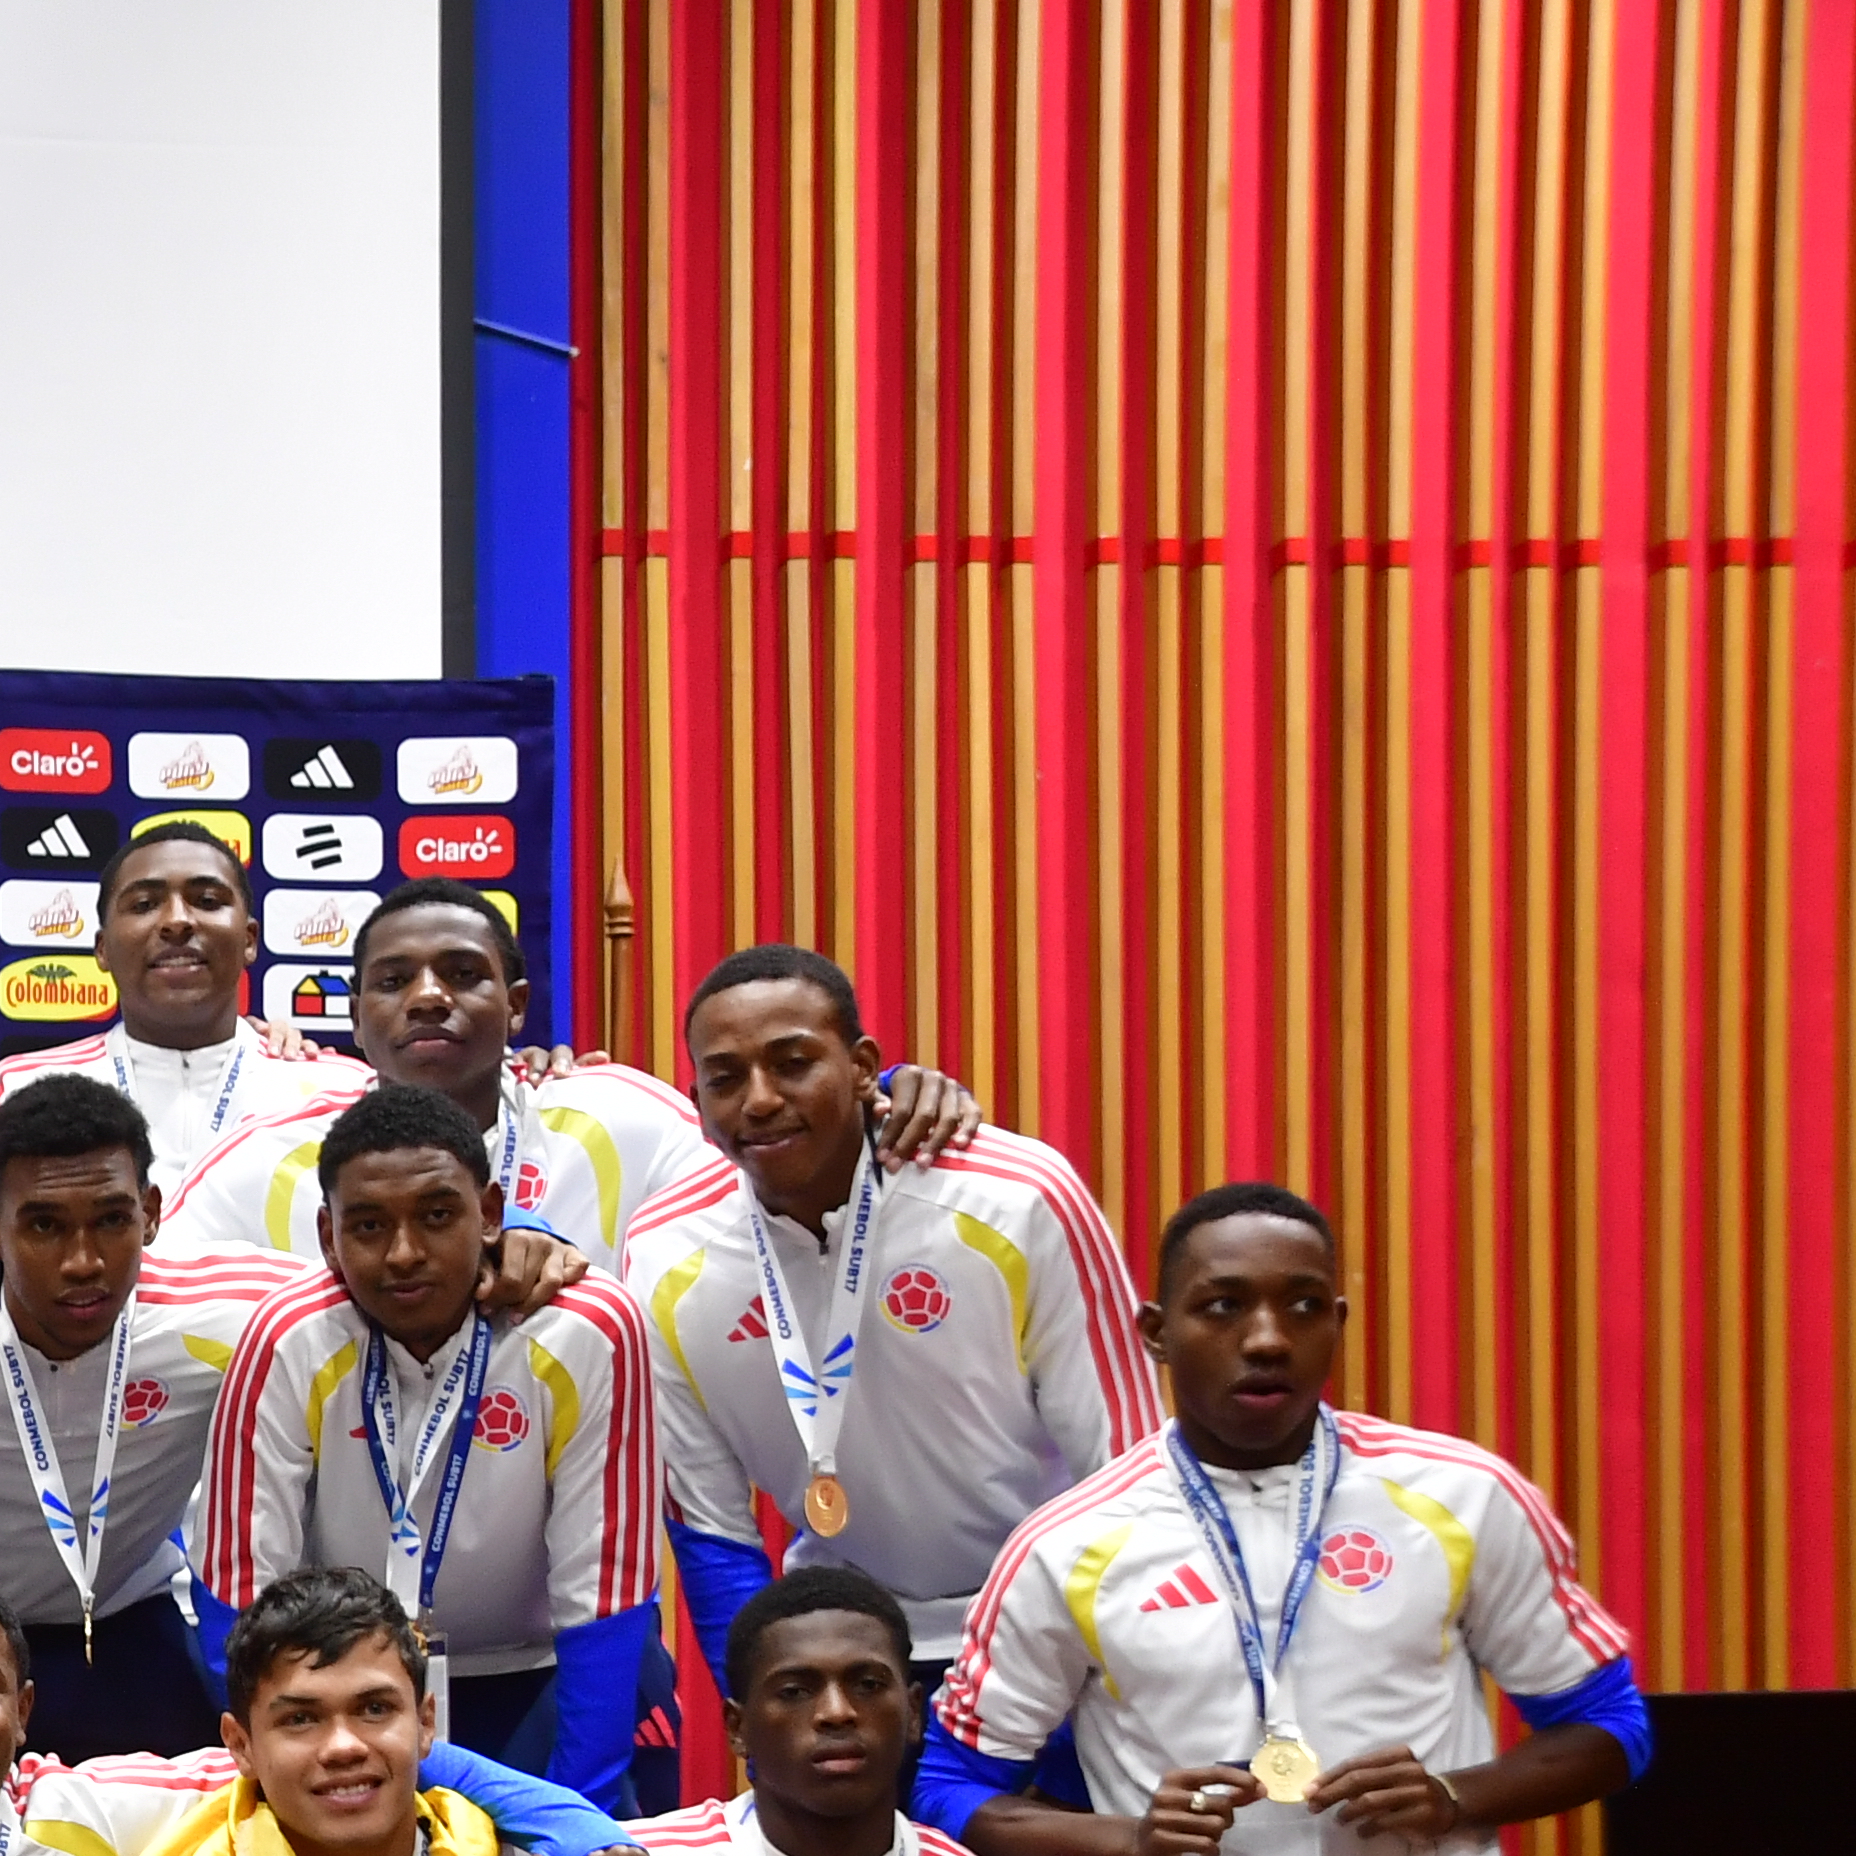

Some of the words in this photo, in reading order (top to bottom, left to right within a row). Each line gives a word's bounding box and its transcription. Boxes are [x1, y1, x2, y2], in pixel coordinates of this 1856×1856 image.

[10, 748, 86, 777] Claro
[415, 834, 490, 863] Claro
[6, 974, 109, 1007] Colombiana
[844, 1247, 864, 1295] SUB17
[762, 1260, 792, 1340] CONMEBOL
[3, 1344, 26, 1387] SUB17
[18, 1385, 50, 1473] CONMEBOL
[105, 1389, 121, 1439] SUB17
[413, 1395, 452, 1476] CONMEBOL
[443, 1347, 470, 1395] SUB17
